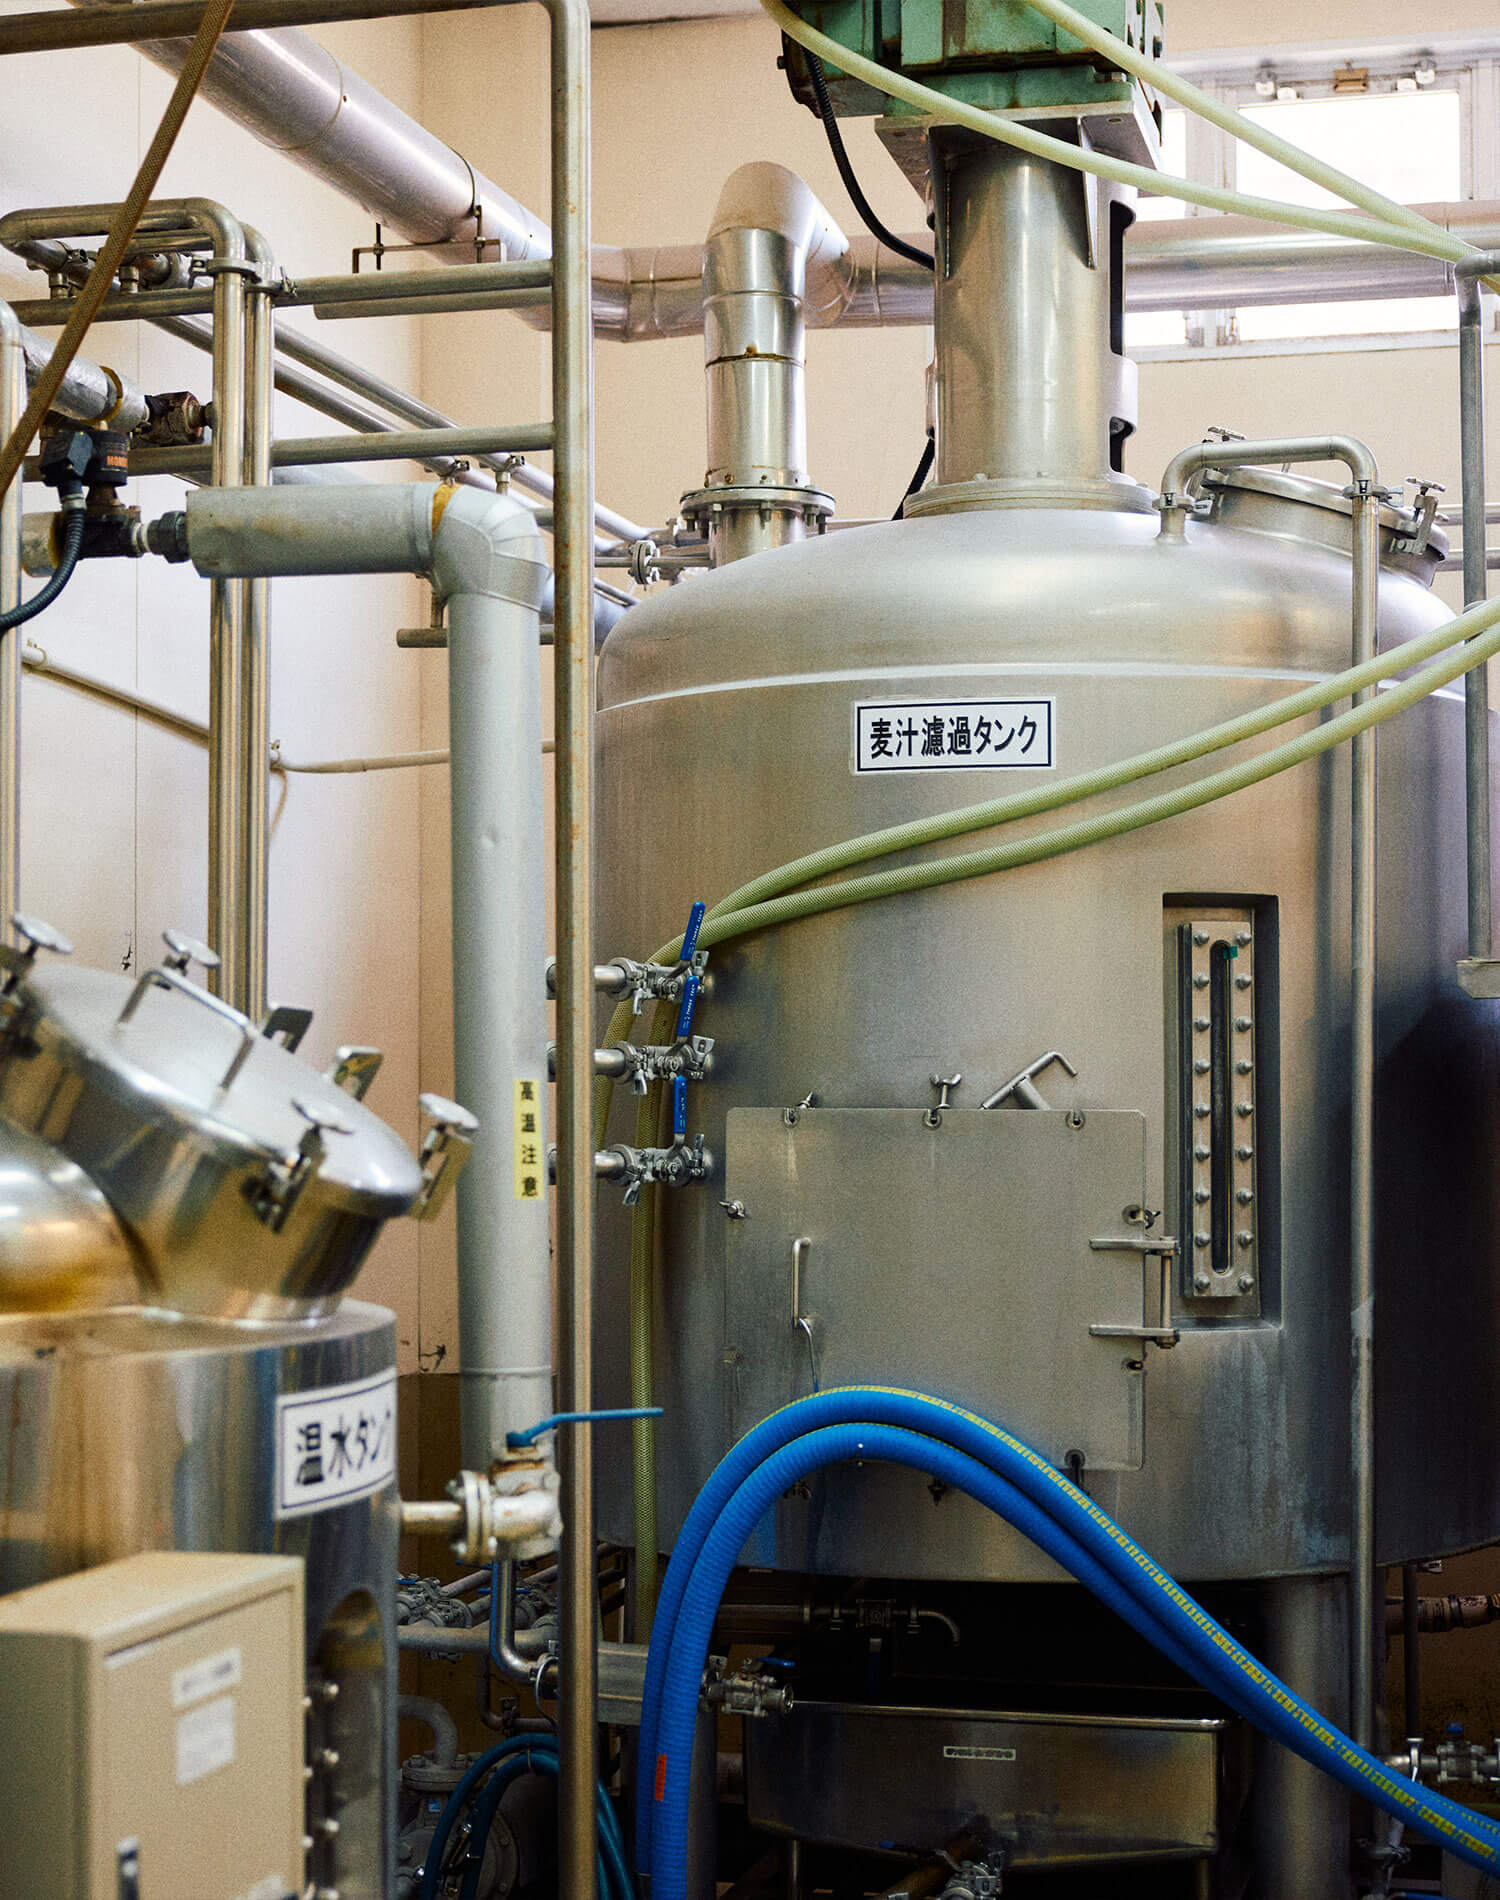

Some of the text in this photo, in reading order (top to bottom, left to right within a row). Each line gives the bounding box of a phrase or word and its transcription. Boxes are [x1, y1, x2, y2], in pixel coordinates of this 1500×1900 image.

[870, 715, 1038, 759] 麦汁濾過タンク
[520, 1081, 538, 1197] 高温注意
